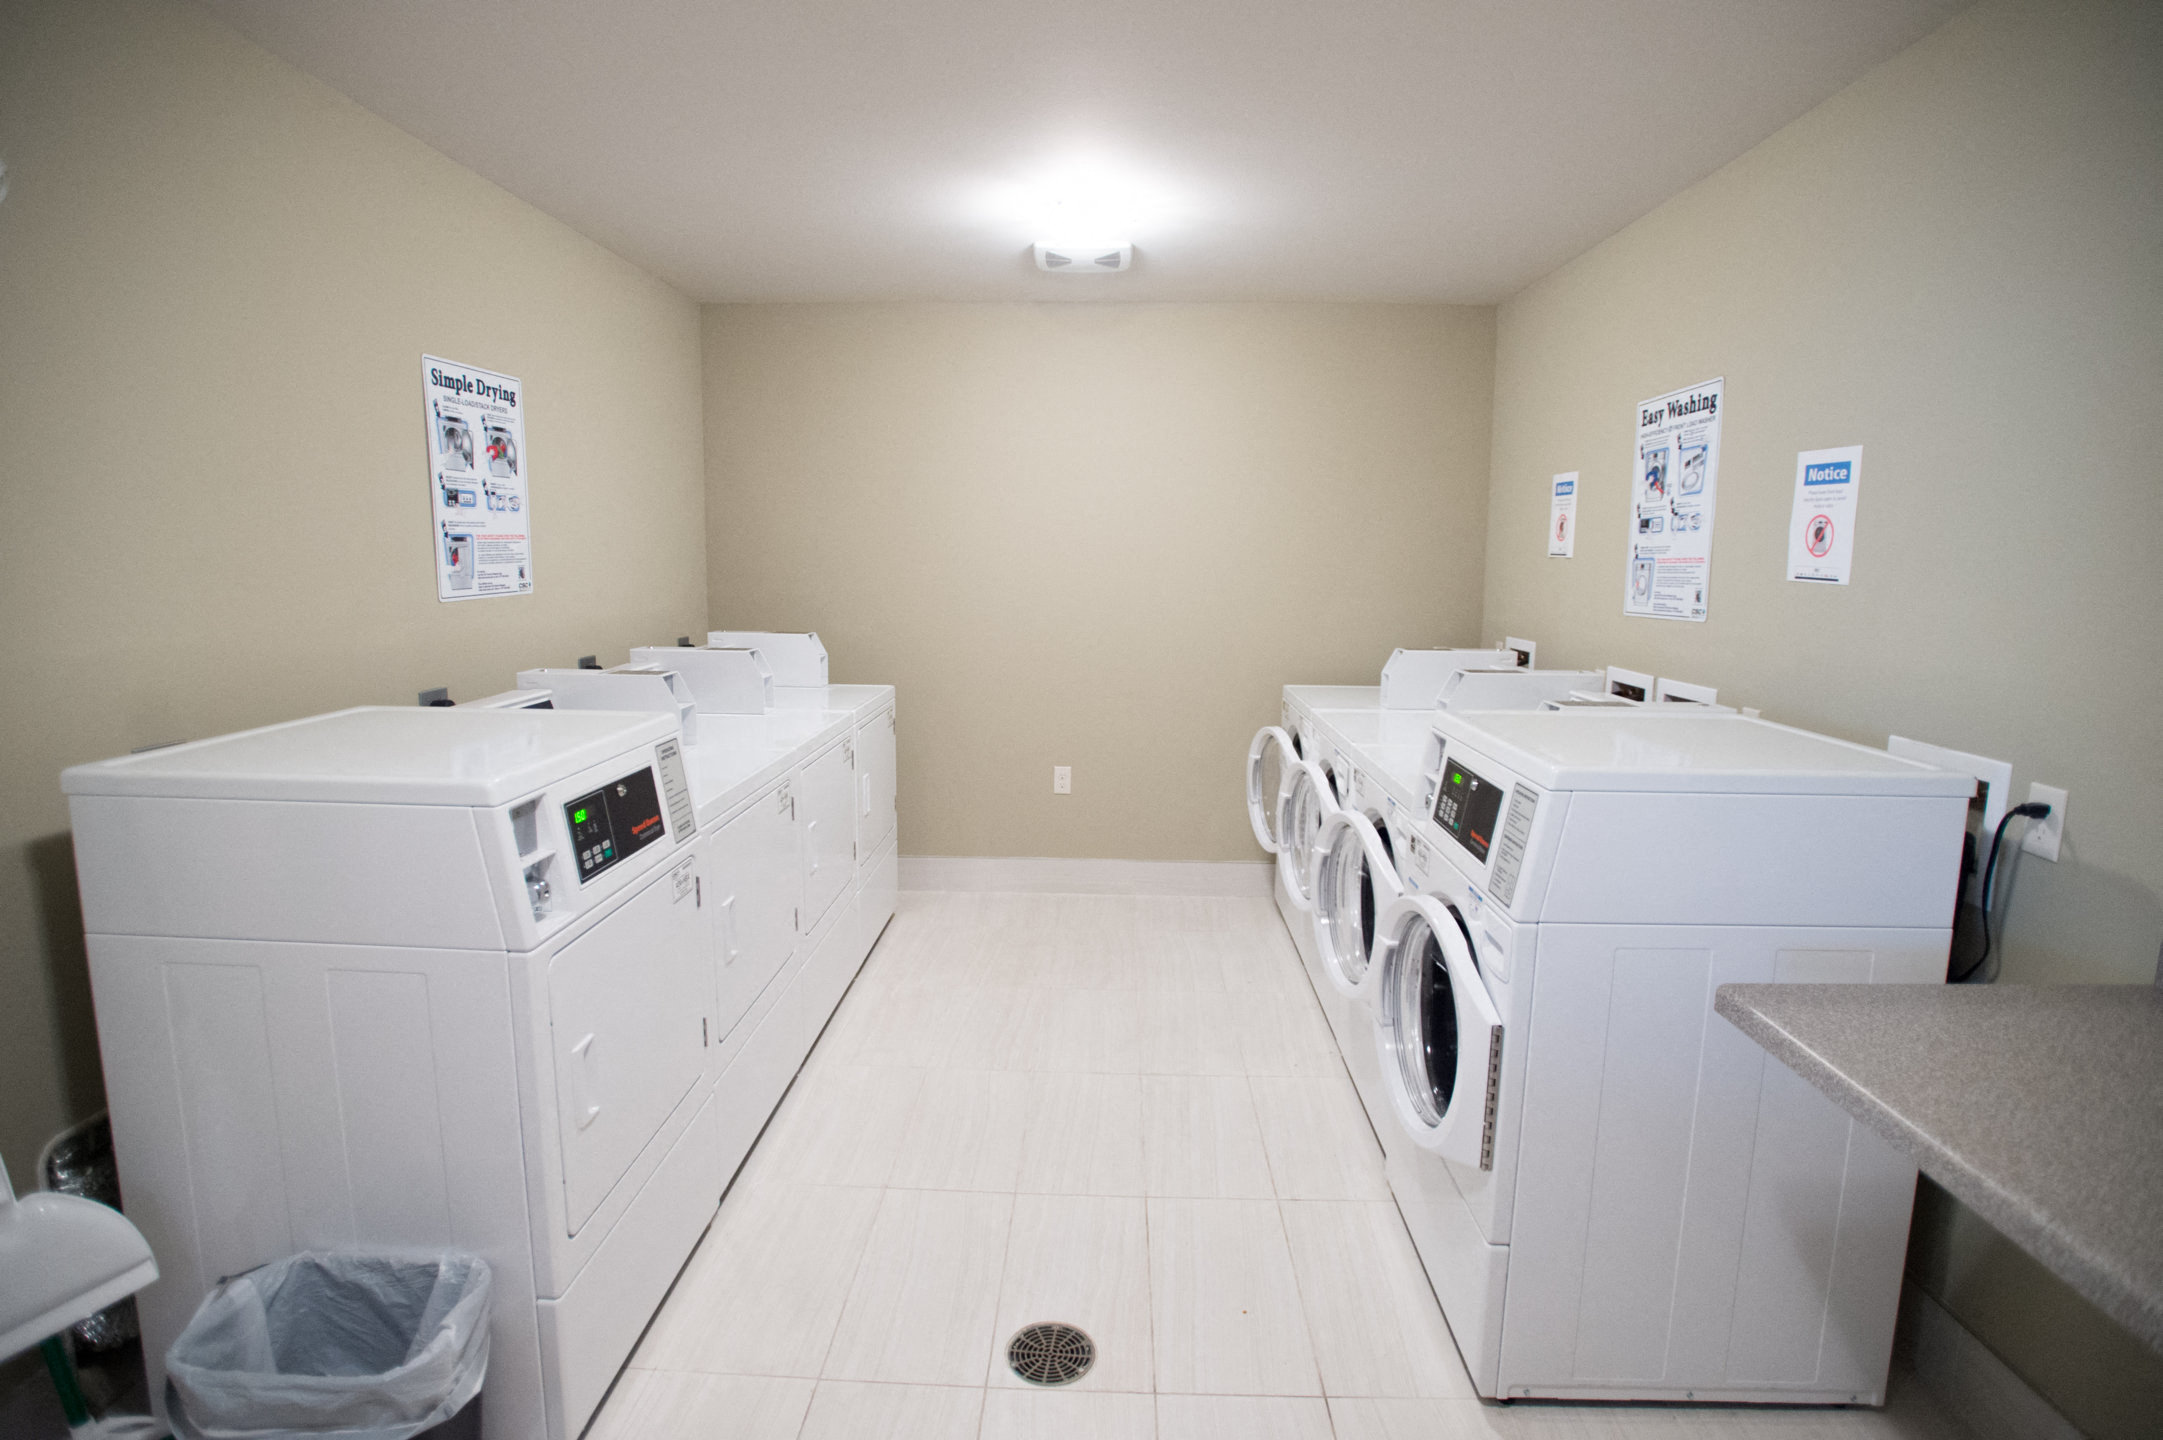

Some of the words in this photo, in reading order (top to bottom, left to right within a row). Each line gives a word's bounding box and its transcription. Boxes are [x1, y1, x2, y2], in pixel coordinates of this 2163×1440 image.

[431, 368, 473, 395] Simple
[476, 378, 516, 407] Drying
[1641, 409, 1664, 427] Easy
[1667, 393, 1718, 419] Washing
[1808, 467, 1848, 481] Notice
